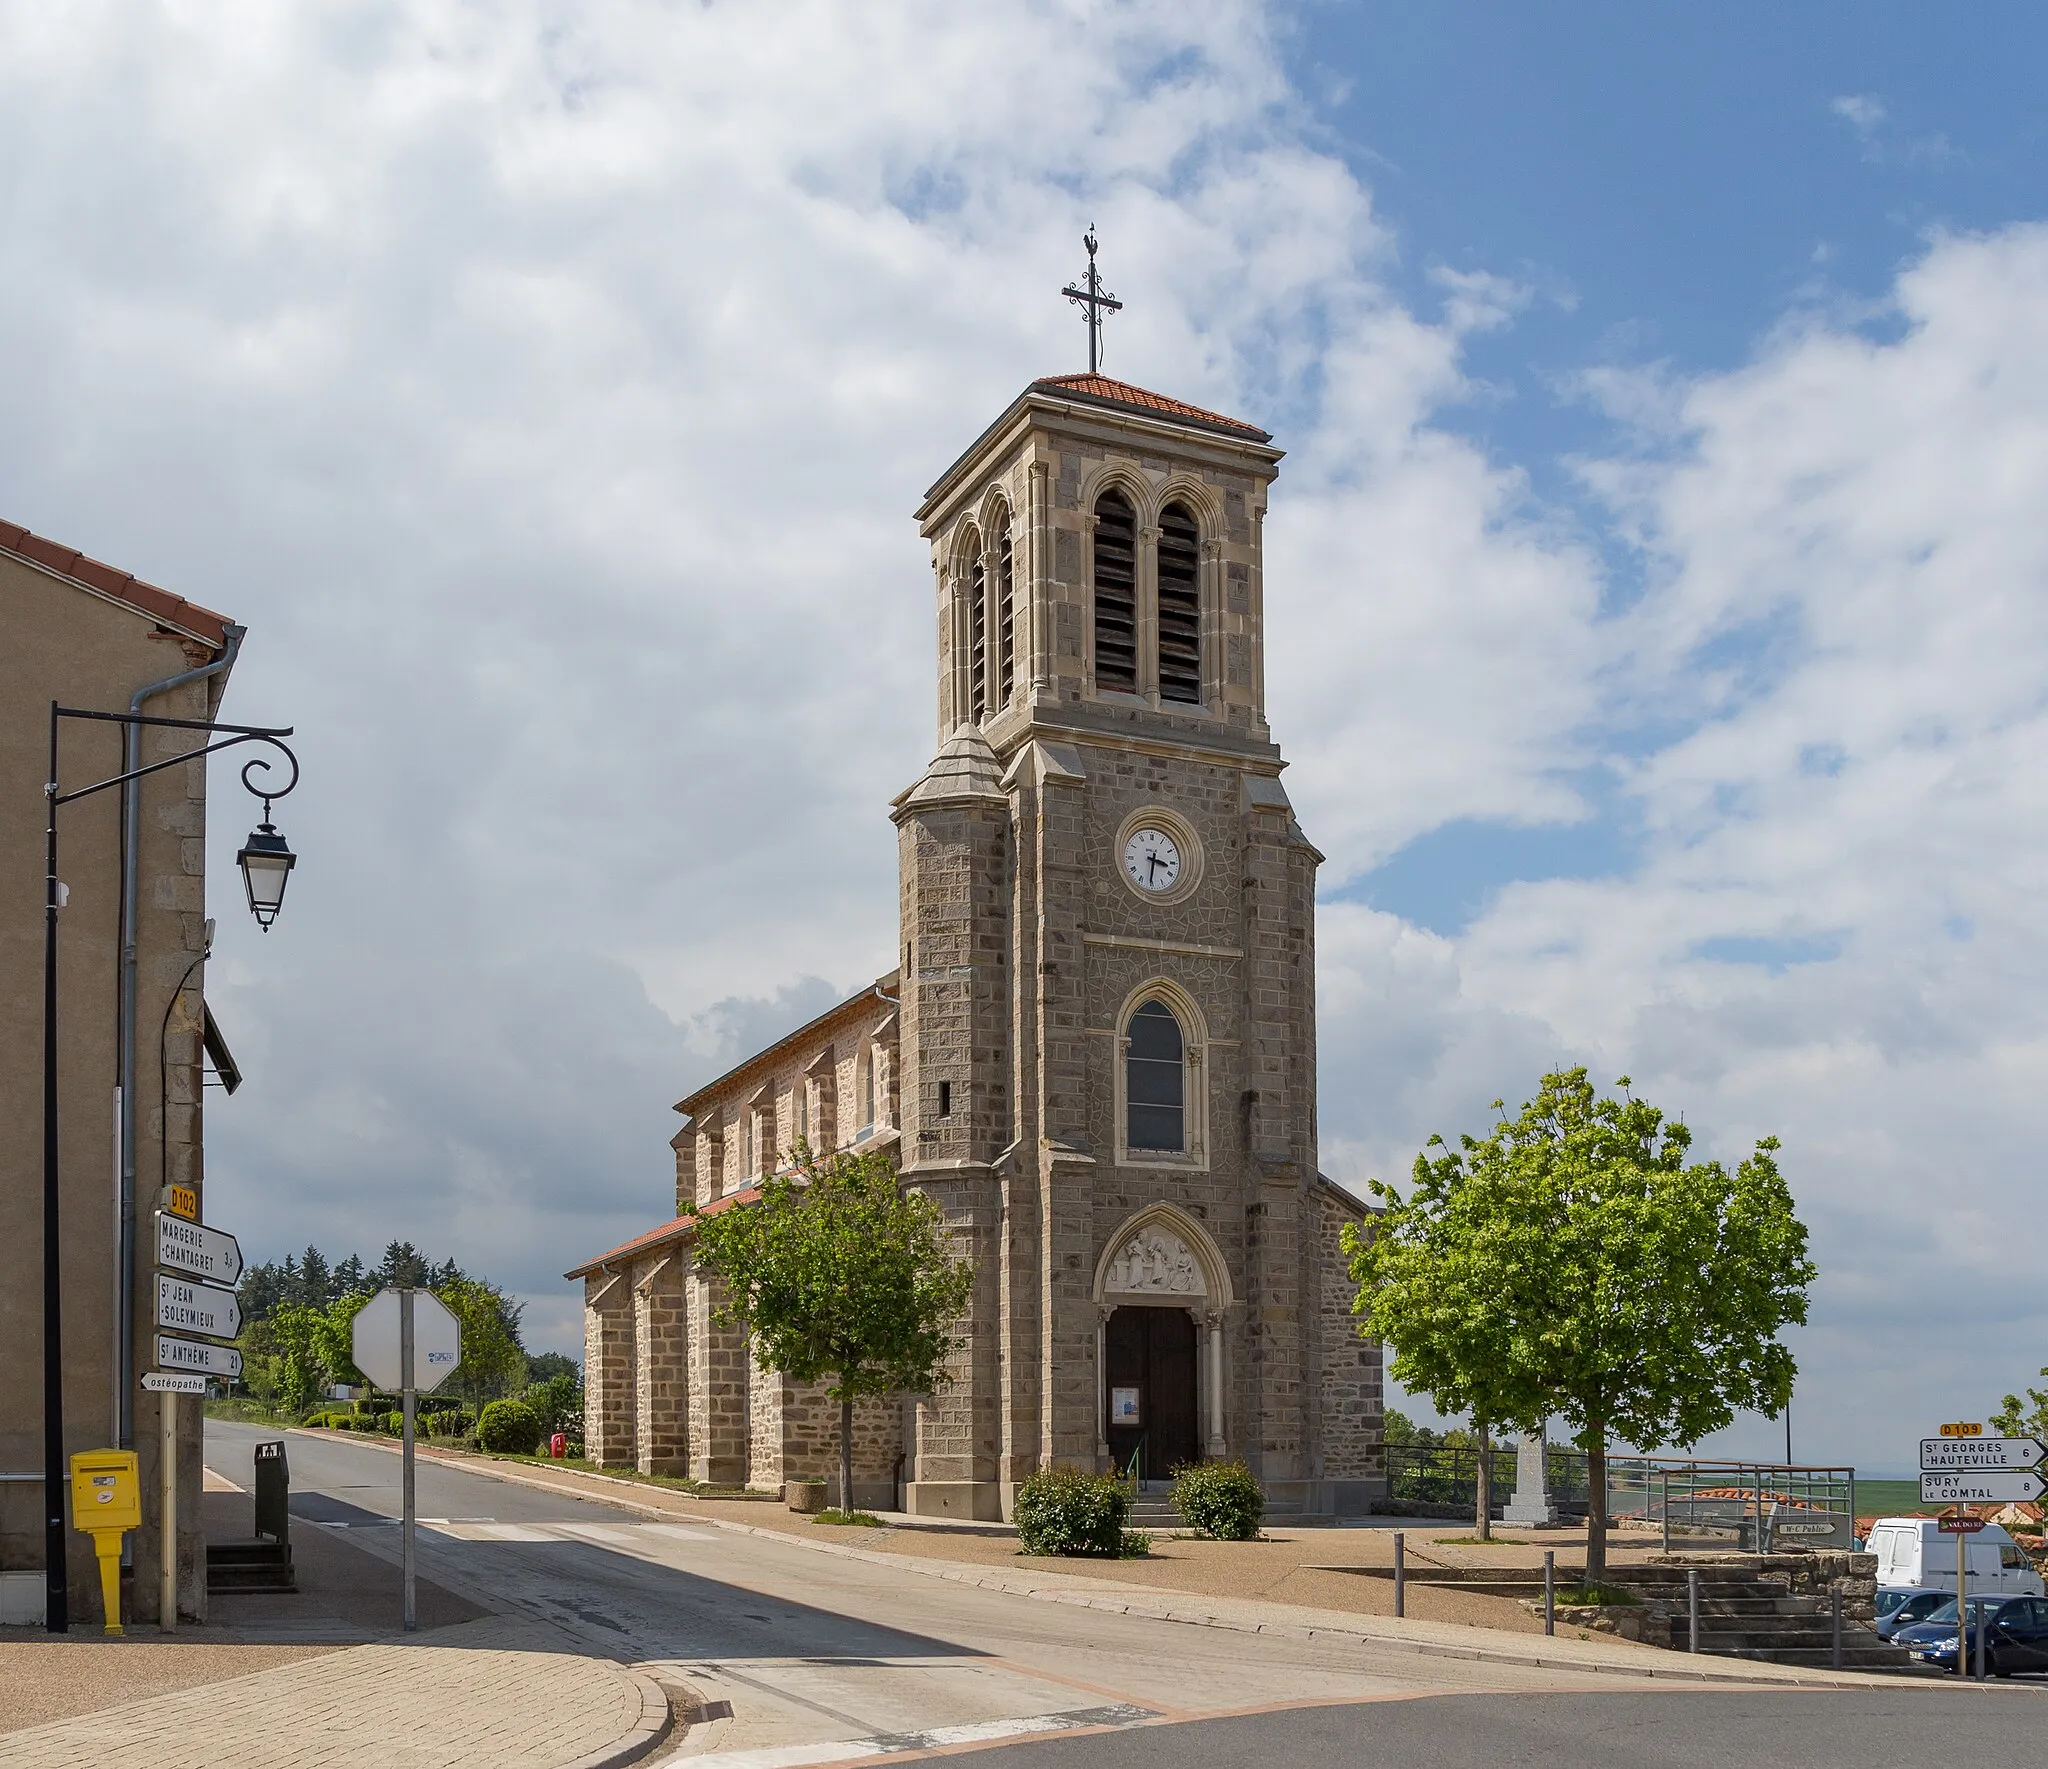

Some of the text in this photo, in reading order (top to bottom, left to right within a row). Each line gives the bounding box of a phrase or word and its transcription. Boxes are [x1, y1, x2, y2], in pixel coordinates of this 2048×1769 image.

[162, 1221, 202, 1248] MARGERIE
[173, 1286, 193, 1304] JEAN
[229, 1309, 233, 1322] 8
[173, 1345, 209, 1366] ANTHÈME
[230, 1355, 238, 1369] 21
[151, 1378, 203, 1390] ostéopathe
[1943, 1443, 2002, 1453] GEORGES
[2022, 1448, 2030, 1457] 6
[1926, 1455, 2007, 1465] -HAUTEVILLE
[1925, 1477, 1960, 1487] SURY
[2023, 1482, 2030, 1491] 8
[1941, 1488, 1993, 1498] COMTAL
